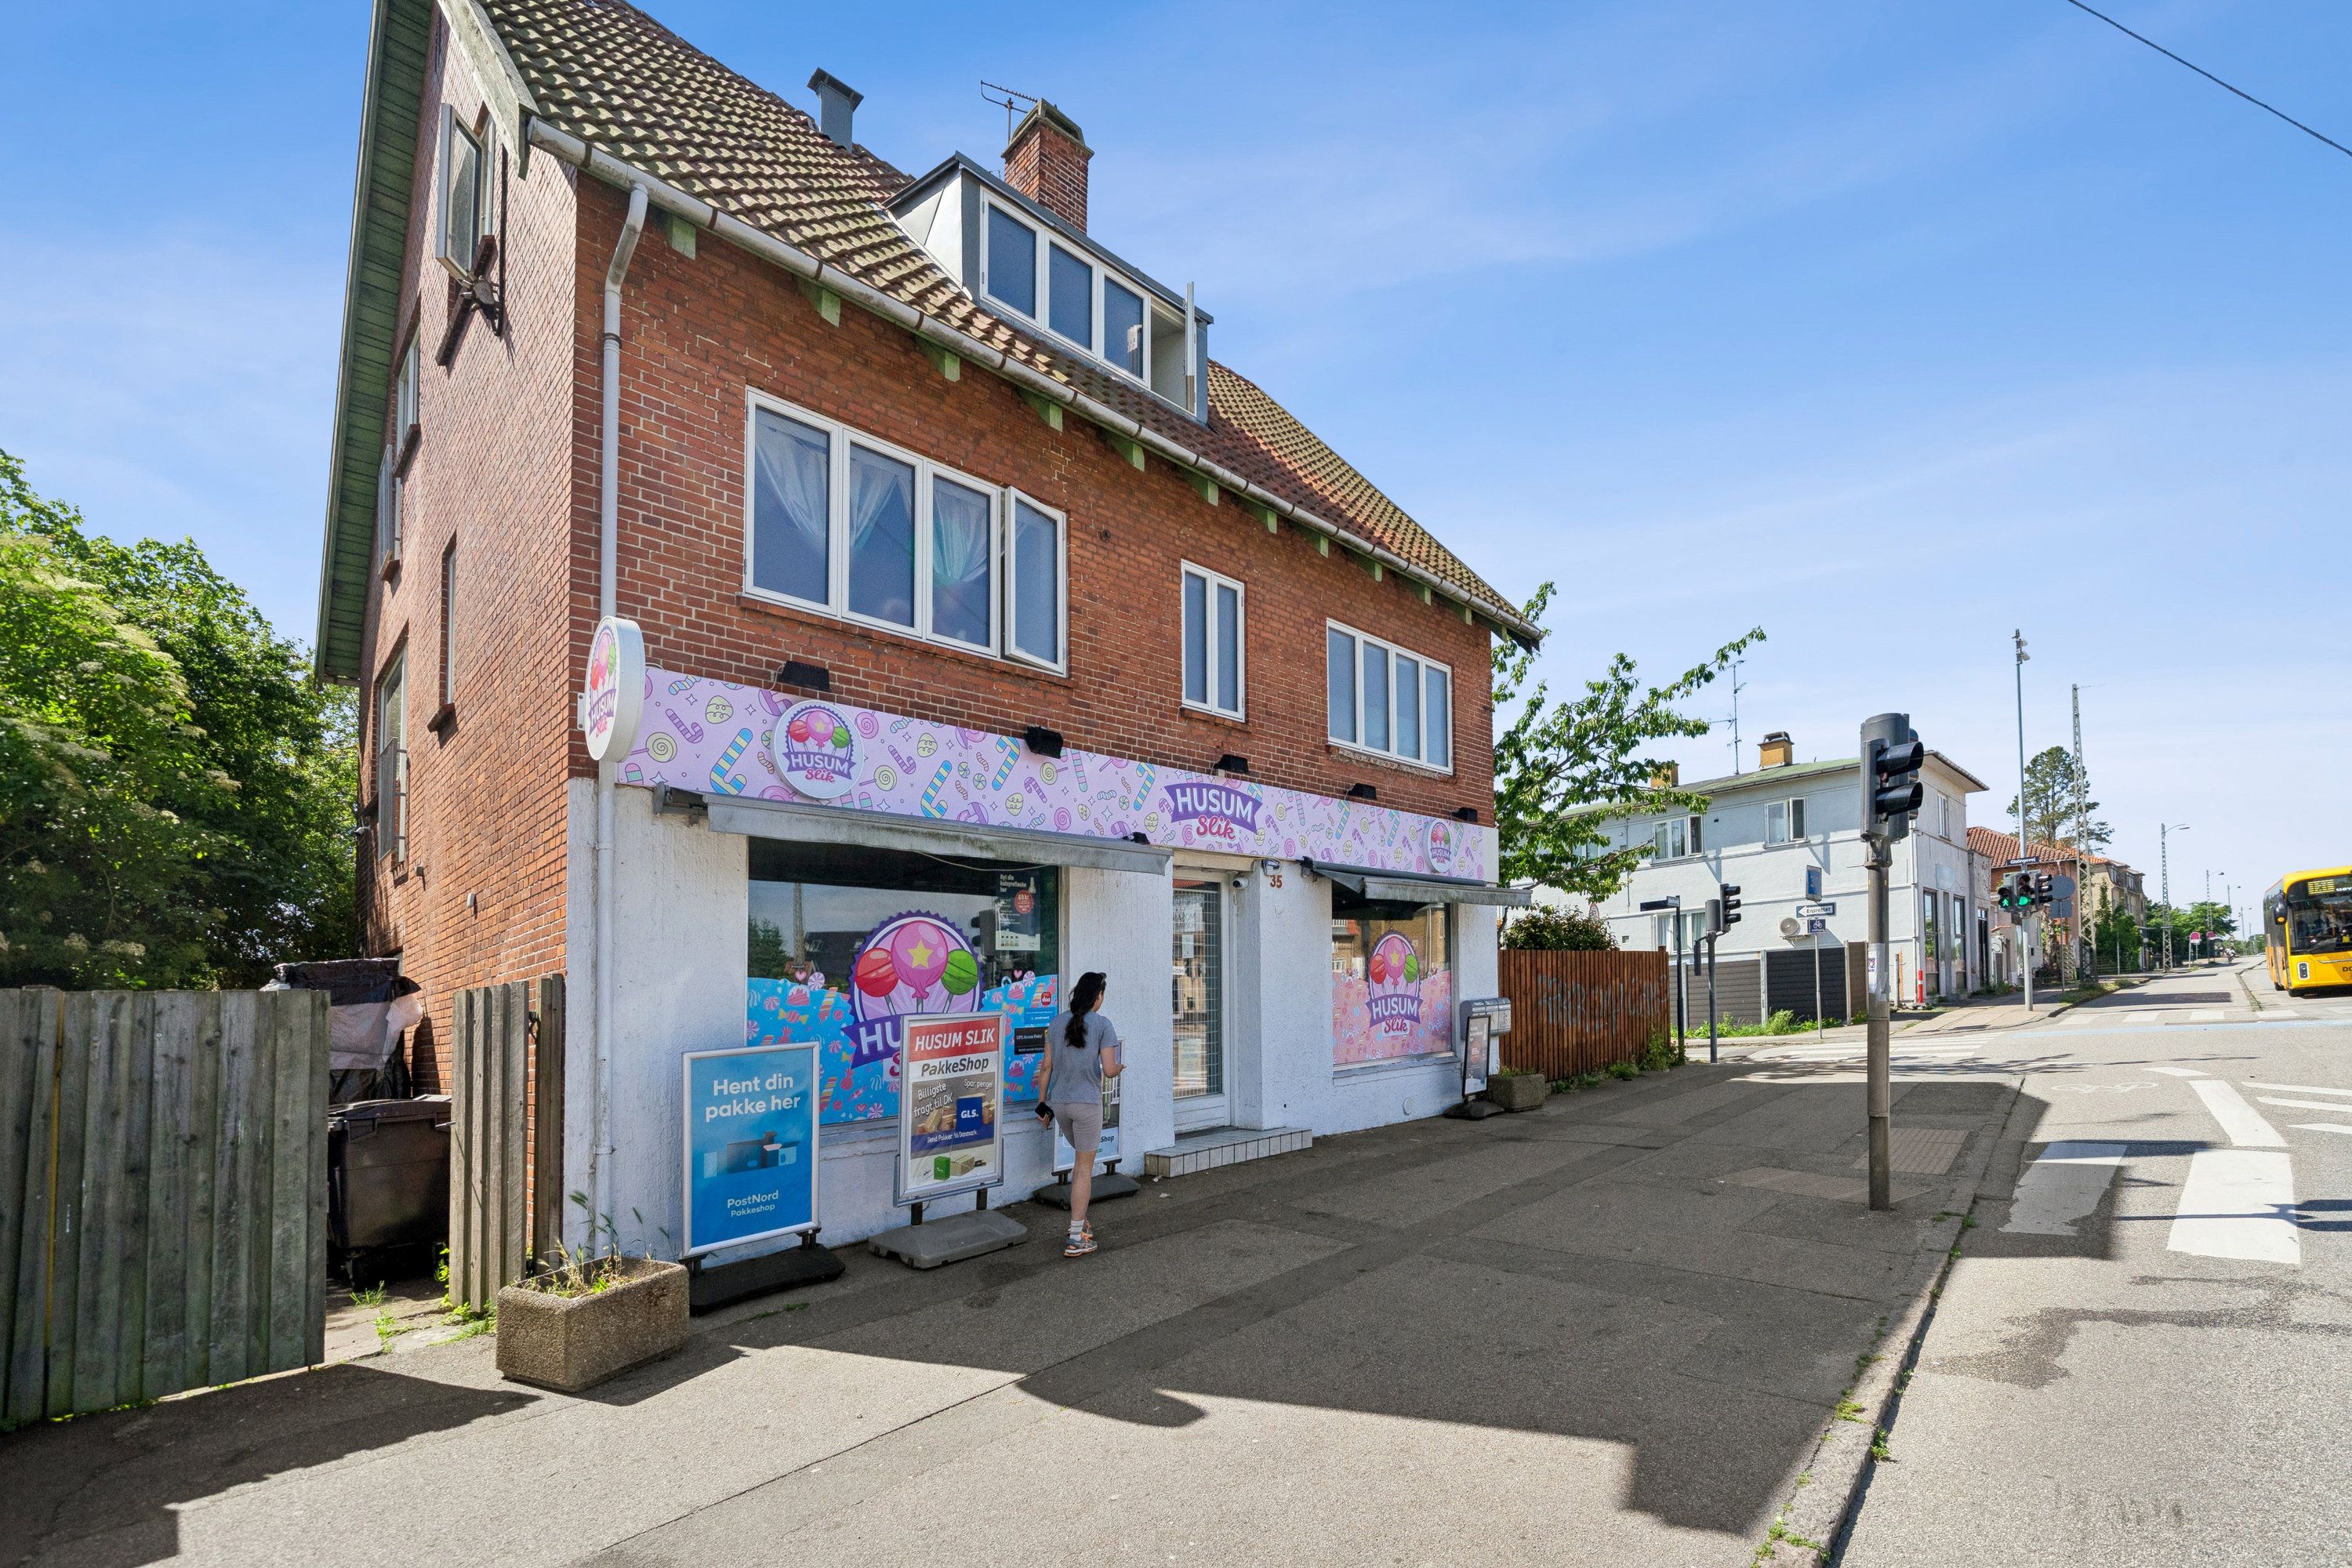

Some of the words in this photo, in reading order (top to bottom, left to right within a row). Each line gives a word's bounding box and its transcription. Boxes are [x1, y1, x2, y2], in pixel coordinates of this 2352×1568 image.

[591, 691, 615, 728] HUSUM
[596, 714, 608, 738] Slik
[790, 753, 848, 775] HUSUM
[805, 768, 835, 782] Slik
[1176, 787, 1254, 822] HUSUM
[1196, 815, 1236, 840] Slik
[1432, 848, 1450, 860] HUSUM
[1270, 875, 1283, 888] 35
[1372, 997, 1417, 1019] HUSUM
[1384, 1016, 1408, 1033] Slik
[915, 1031, 962, 1051] HUSUM
[966, 1027, 996, 1046] SLIK
[921, 1057, 989, 1076] PakkeShop
[713, 1077, 760, 1096] Hent
[765, 1073, 793, 1091] din
[917, 1082, 947, 1101] Billigste
[964, 1078, 975, 1089] Spar
[706, 1098, 767, 1123] pakke
[771, 1094, 800, 1111] her
[913, 1101, 933, 1117] fragt
[934, 1097, 942, 1109] til
[943, 1092, 953, 1105] DK
[927, 1134, 938, 1144] Send
[959, 1129, 978, 1138] Danmark
[727, 1189, 779, 1209] PostNord
[731, 1203, 775, 1218] Pakkeshop
